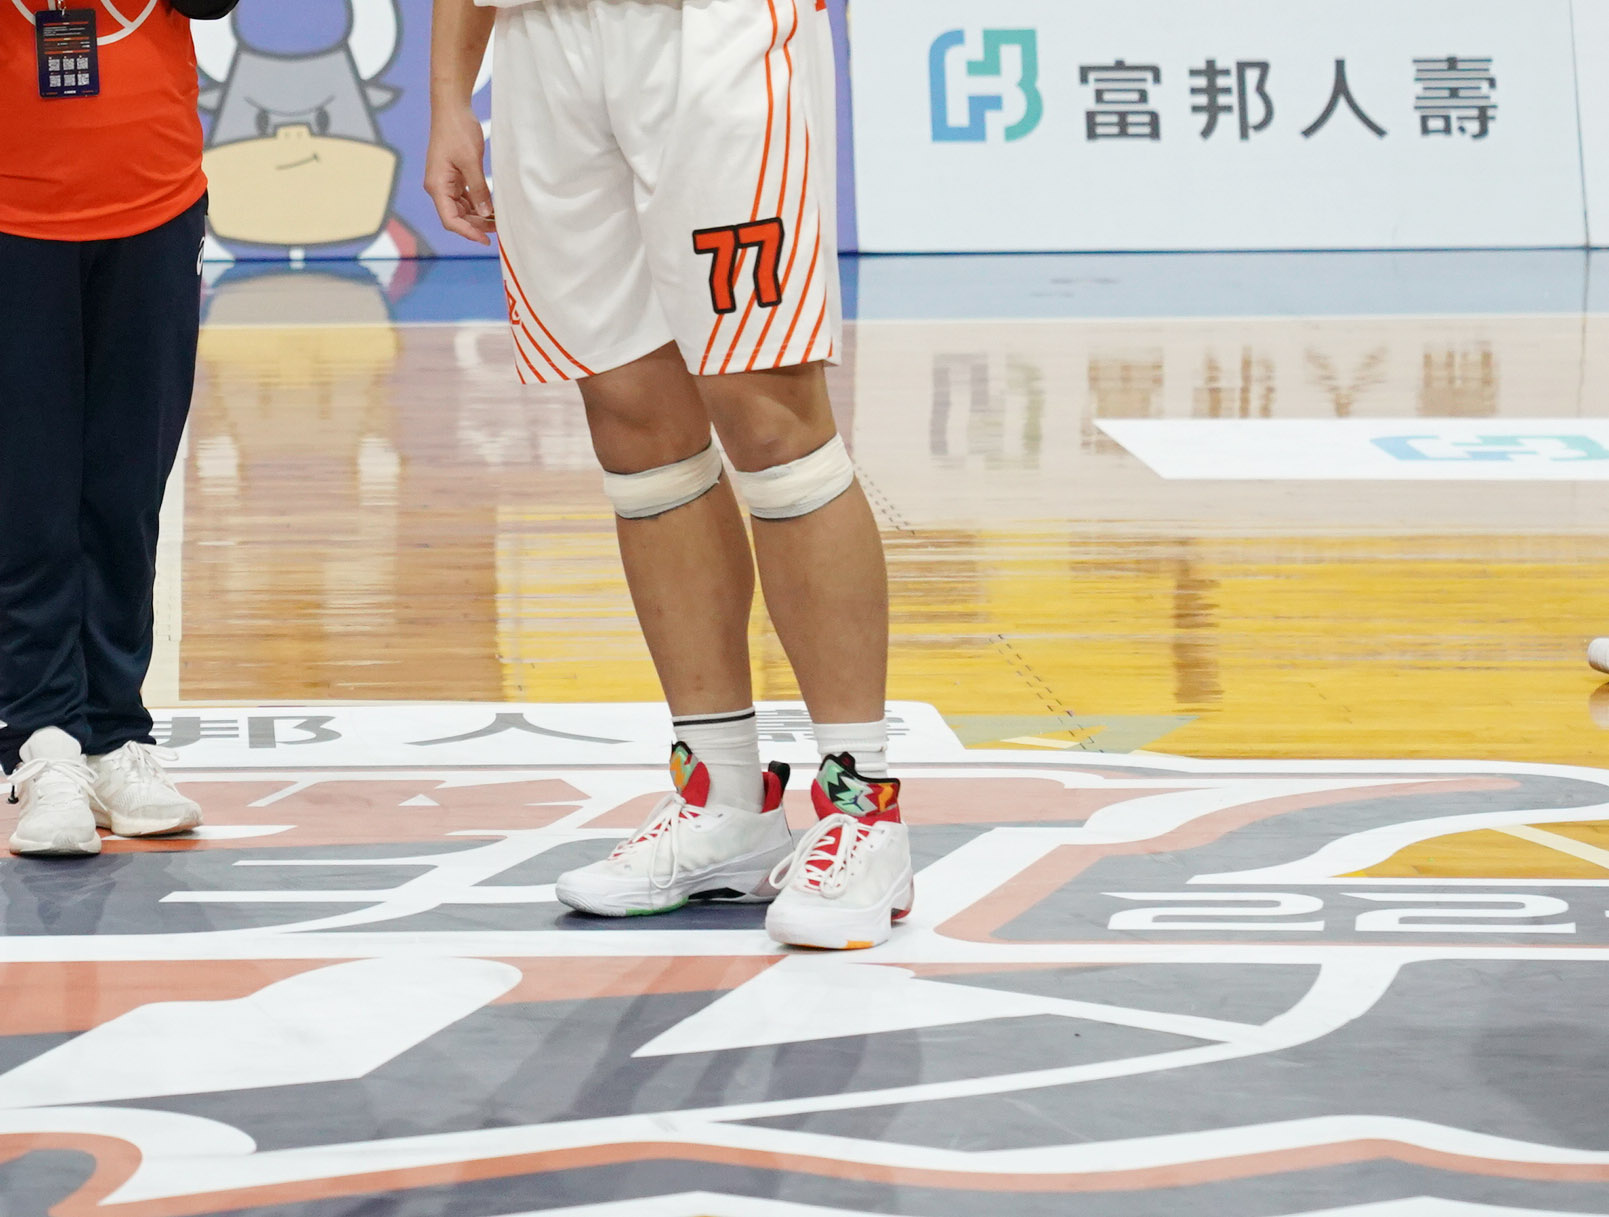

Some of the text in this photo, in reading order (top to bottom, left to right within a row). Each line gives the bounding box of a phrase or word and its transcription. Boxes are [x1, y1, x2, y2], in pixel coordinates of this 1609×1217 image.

[1078, 56, 1498, 141] 富邦人壽
[692, 217, 785, 315] 77
